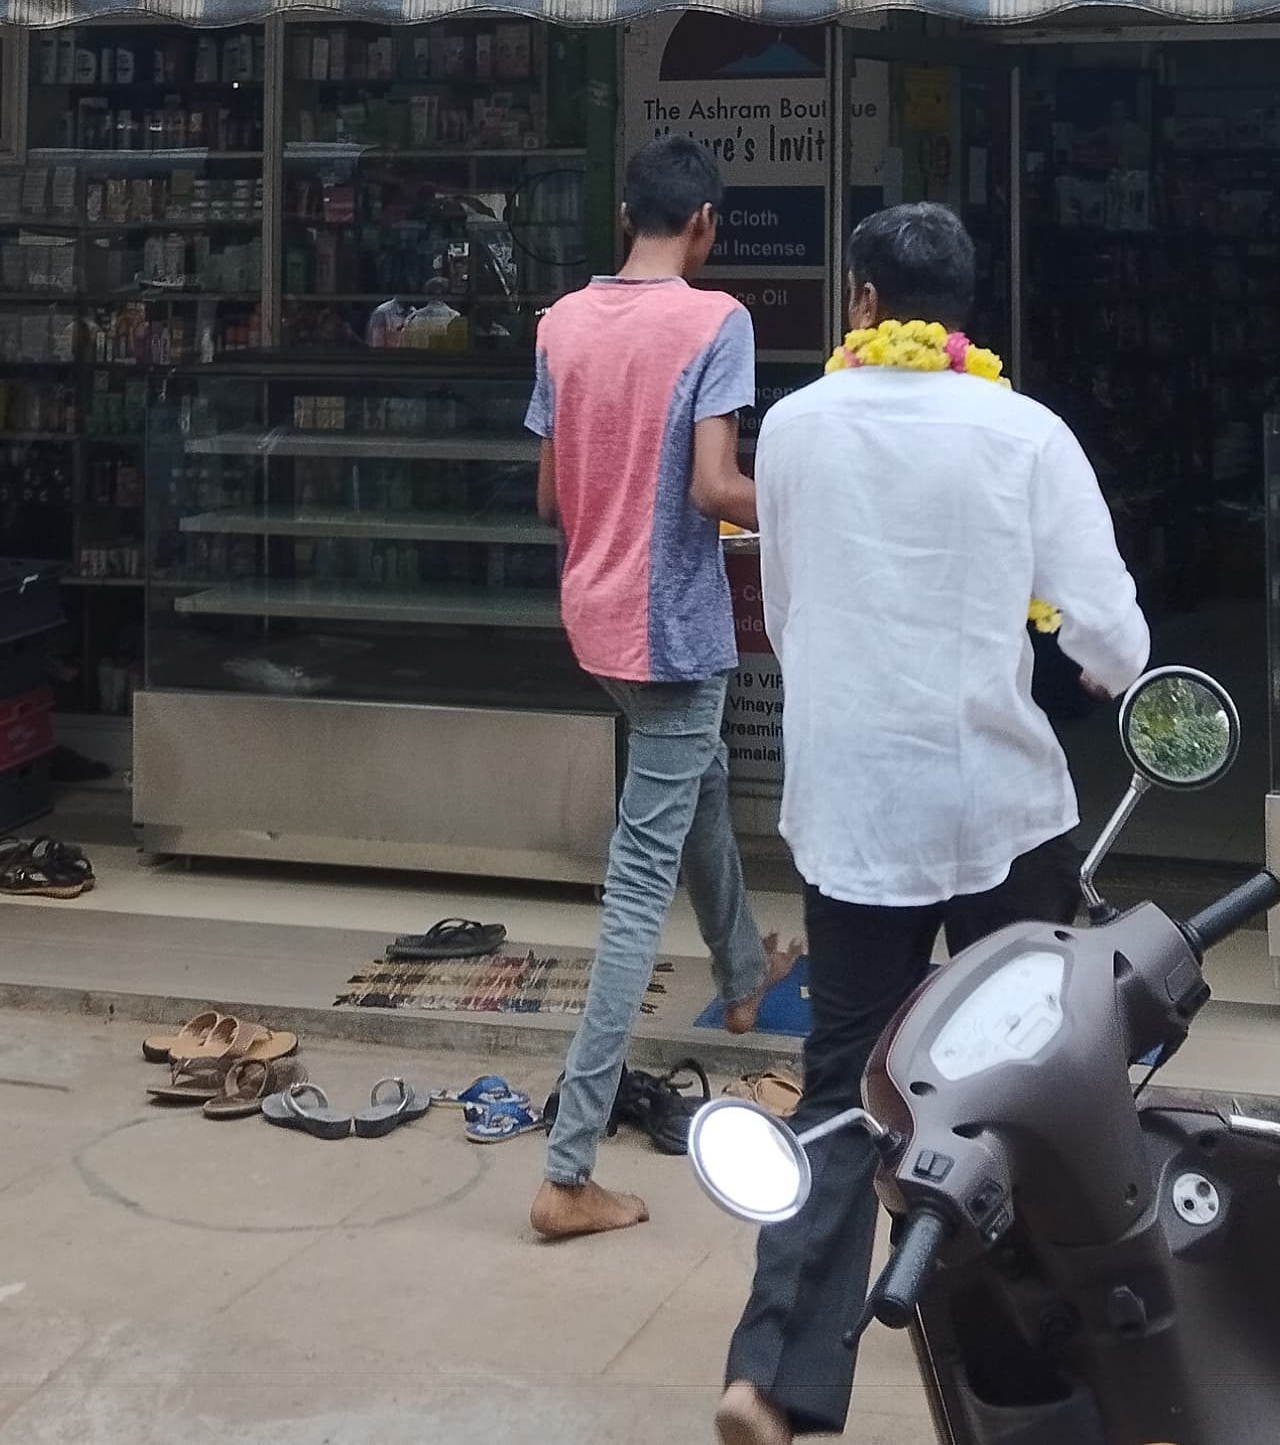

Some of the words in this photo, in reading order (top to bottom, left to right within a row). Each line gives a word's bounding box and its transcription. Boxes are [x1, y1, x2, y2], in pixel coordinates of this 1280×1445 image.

[644, 99, 681, 121] The
[688, 97, 771, 120] Ashram
[769, 124, 826, 162] Invit
[728, 209, 779, 227] Cloth
[733, 239, 807, 258] Incense
[761, 289, 788, 306] Oil
